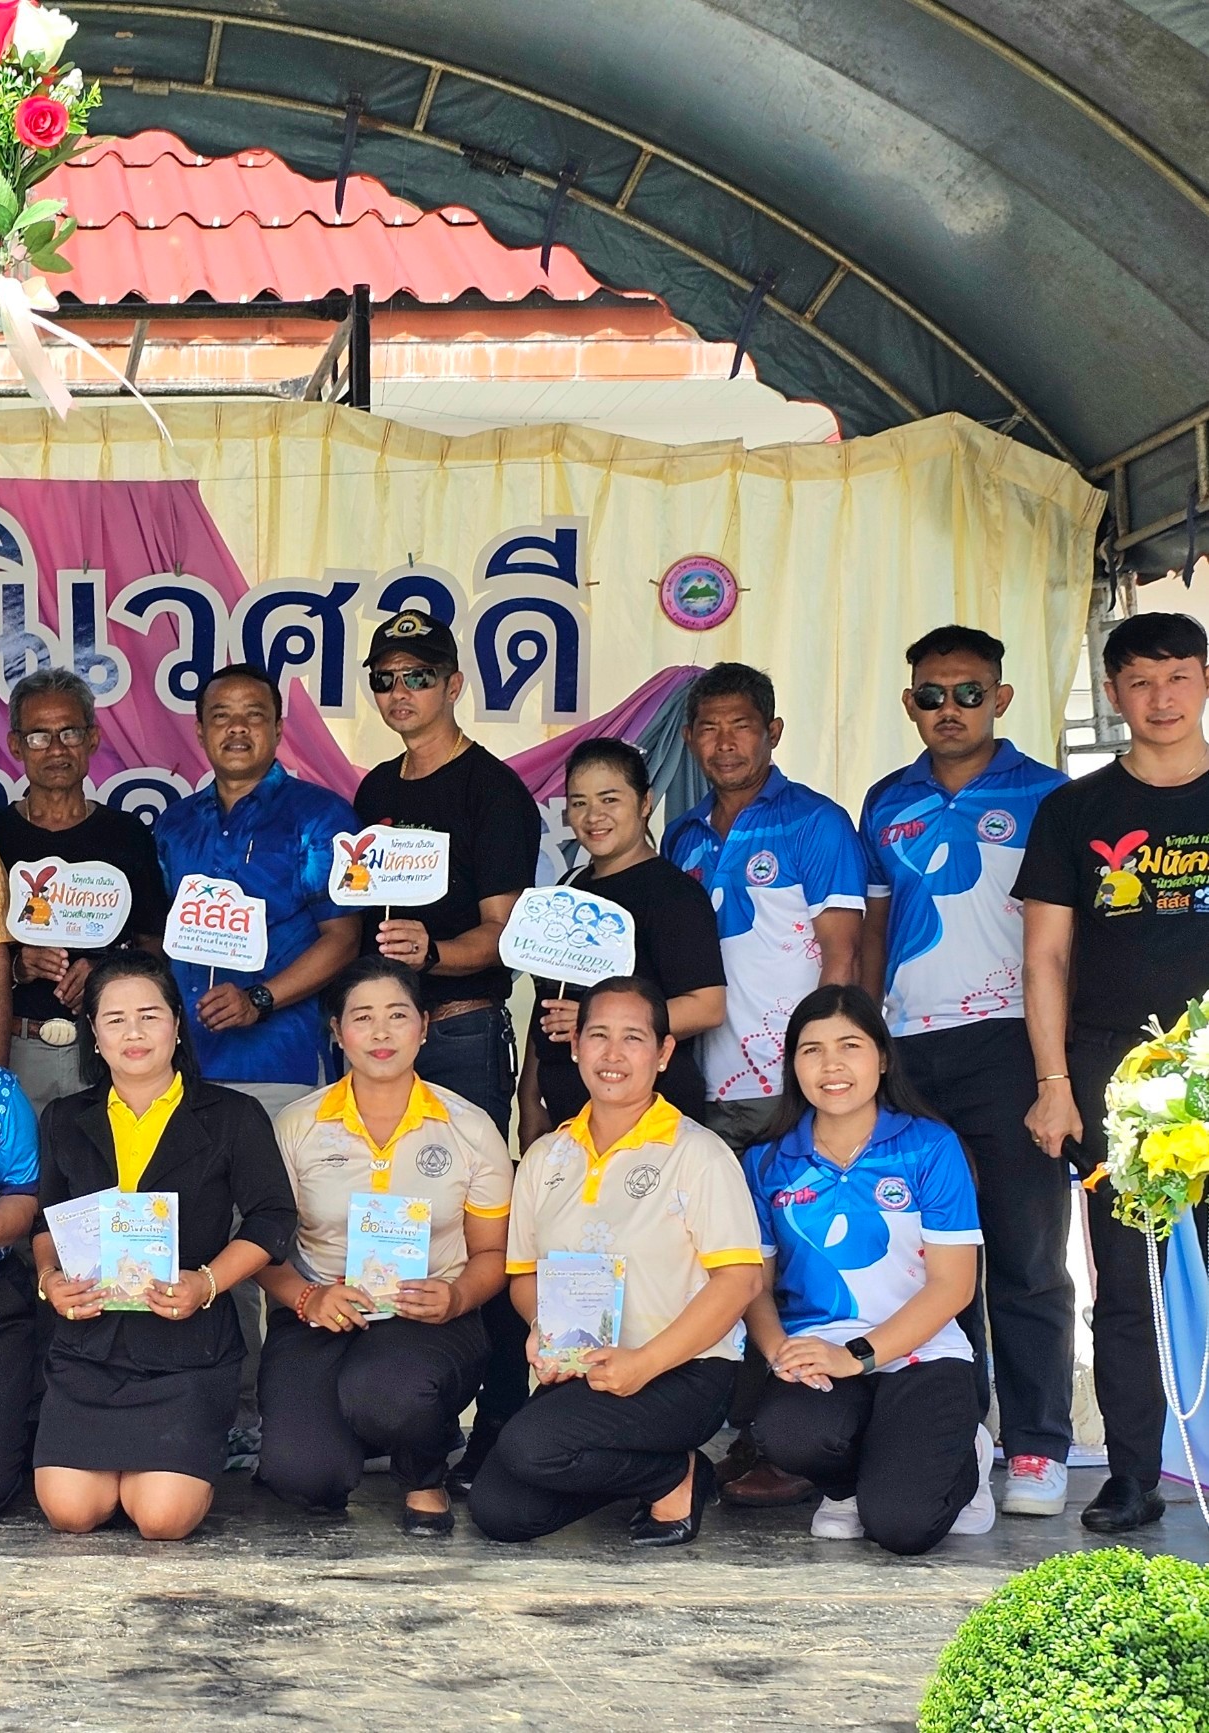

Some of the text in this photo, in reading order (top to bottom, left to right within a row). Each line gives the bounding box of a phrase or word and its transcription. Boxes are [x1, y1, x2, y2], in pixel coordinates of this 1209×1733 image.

[879, 820, 927, 848] 27th
[368, 847, 442, 871] มหัศจรรย์
[1137, 844, 1209, 877] มหัศจ
[49, 881, 122, 909] มหัศจรรย์
[1156, 893, 1192, 910] สสส
[179, 898, 256, 934] สสส
